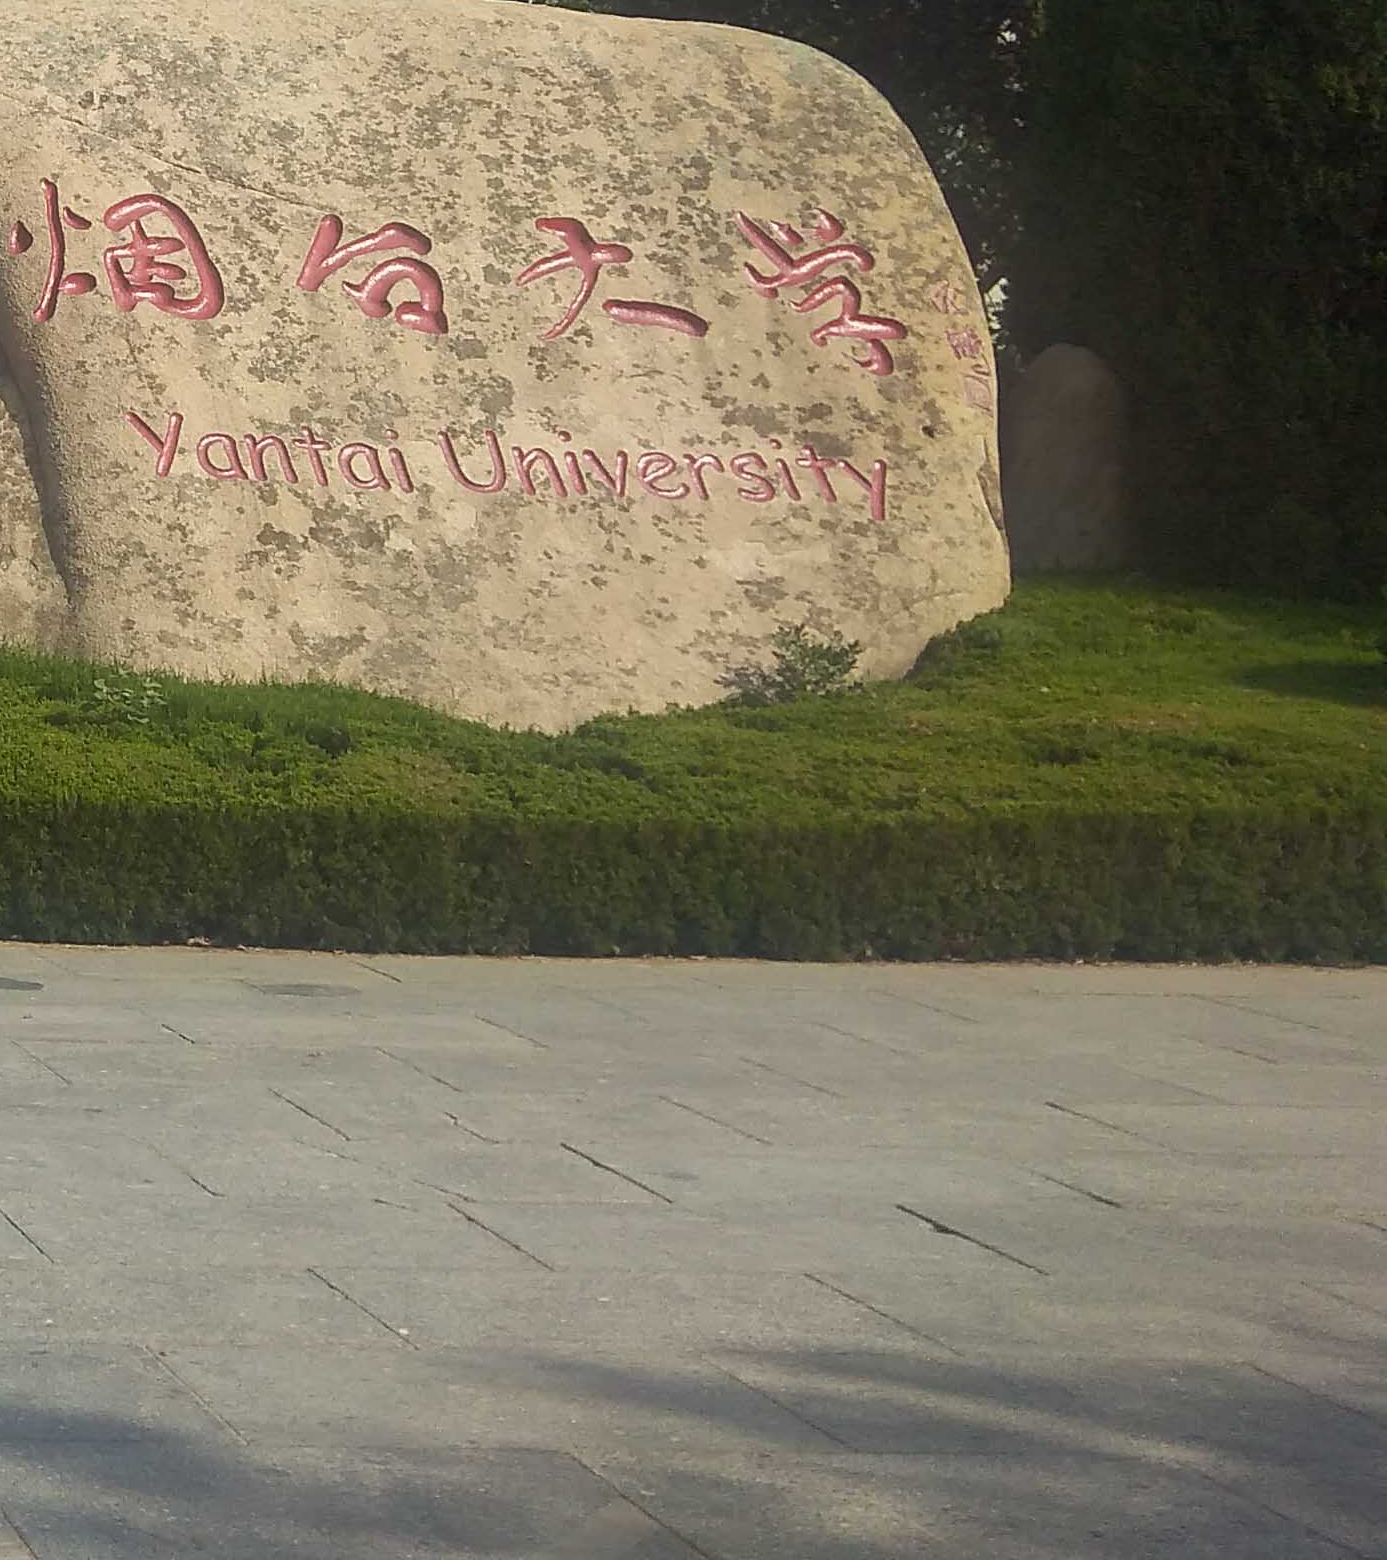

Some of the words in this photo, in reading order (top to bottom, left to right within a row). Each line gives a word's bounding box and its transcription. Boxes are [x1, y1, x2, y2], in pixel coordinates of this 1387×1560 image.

[8, 177, 909, 377] 烟台大学
[126, 410, 414, 495] Yantai
[438, 427, 888, 523] University
